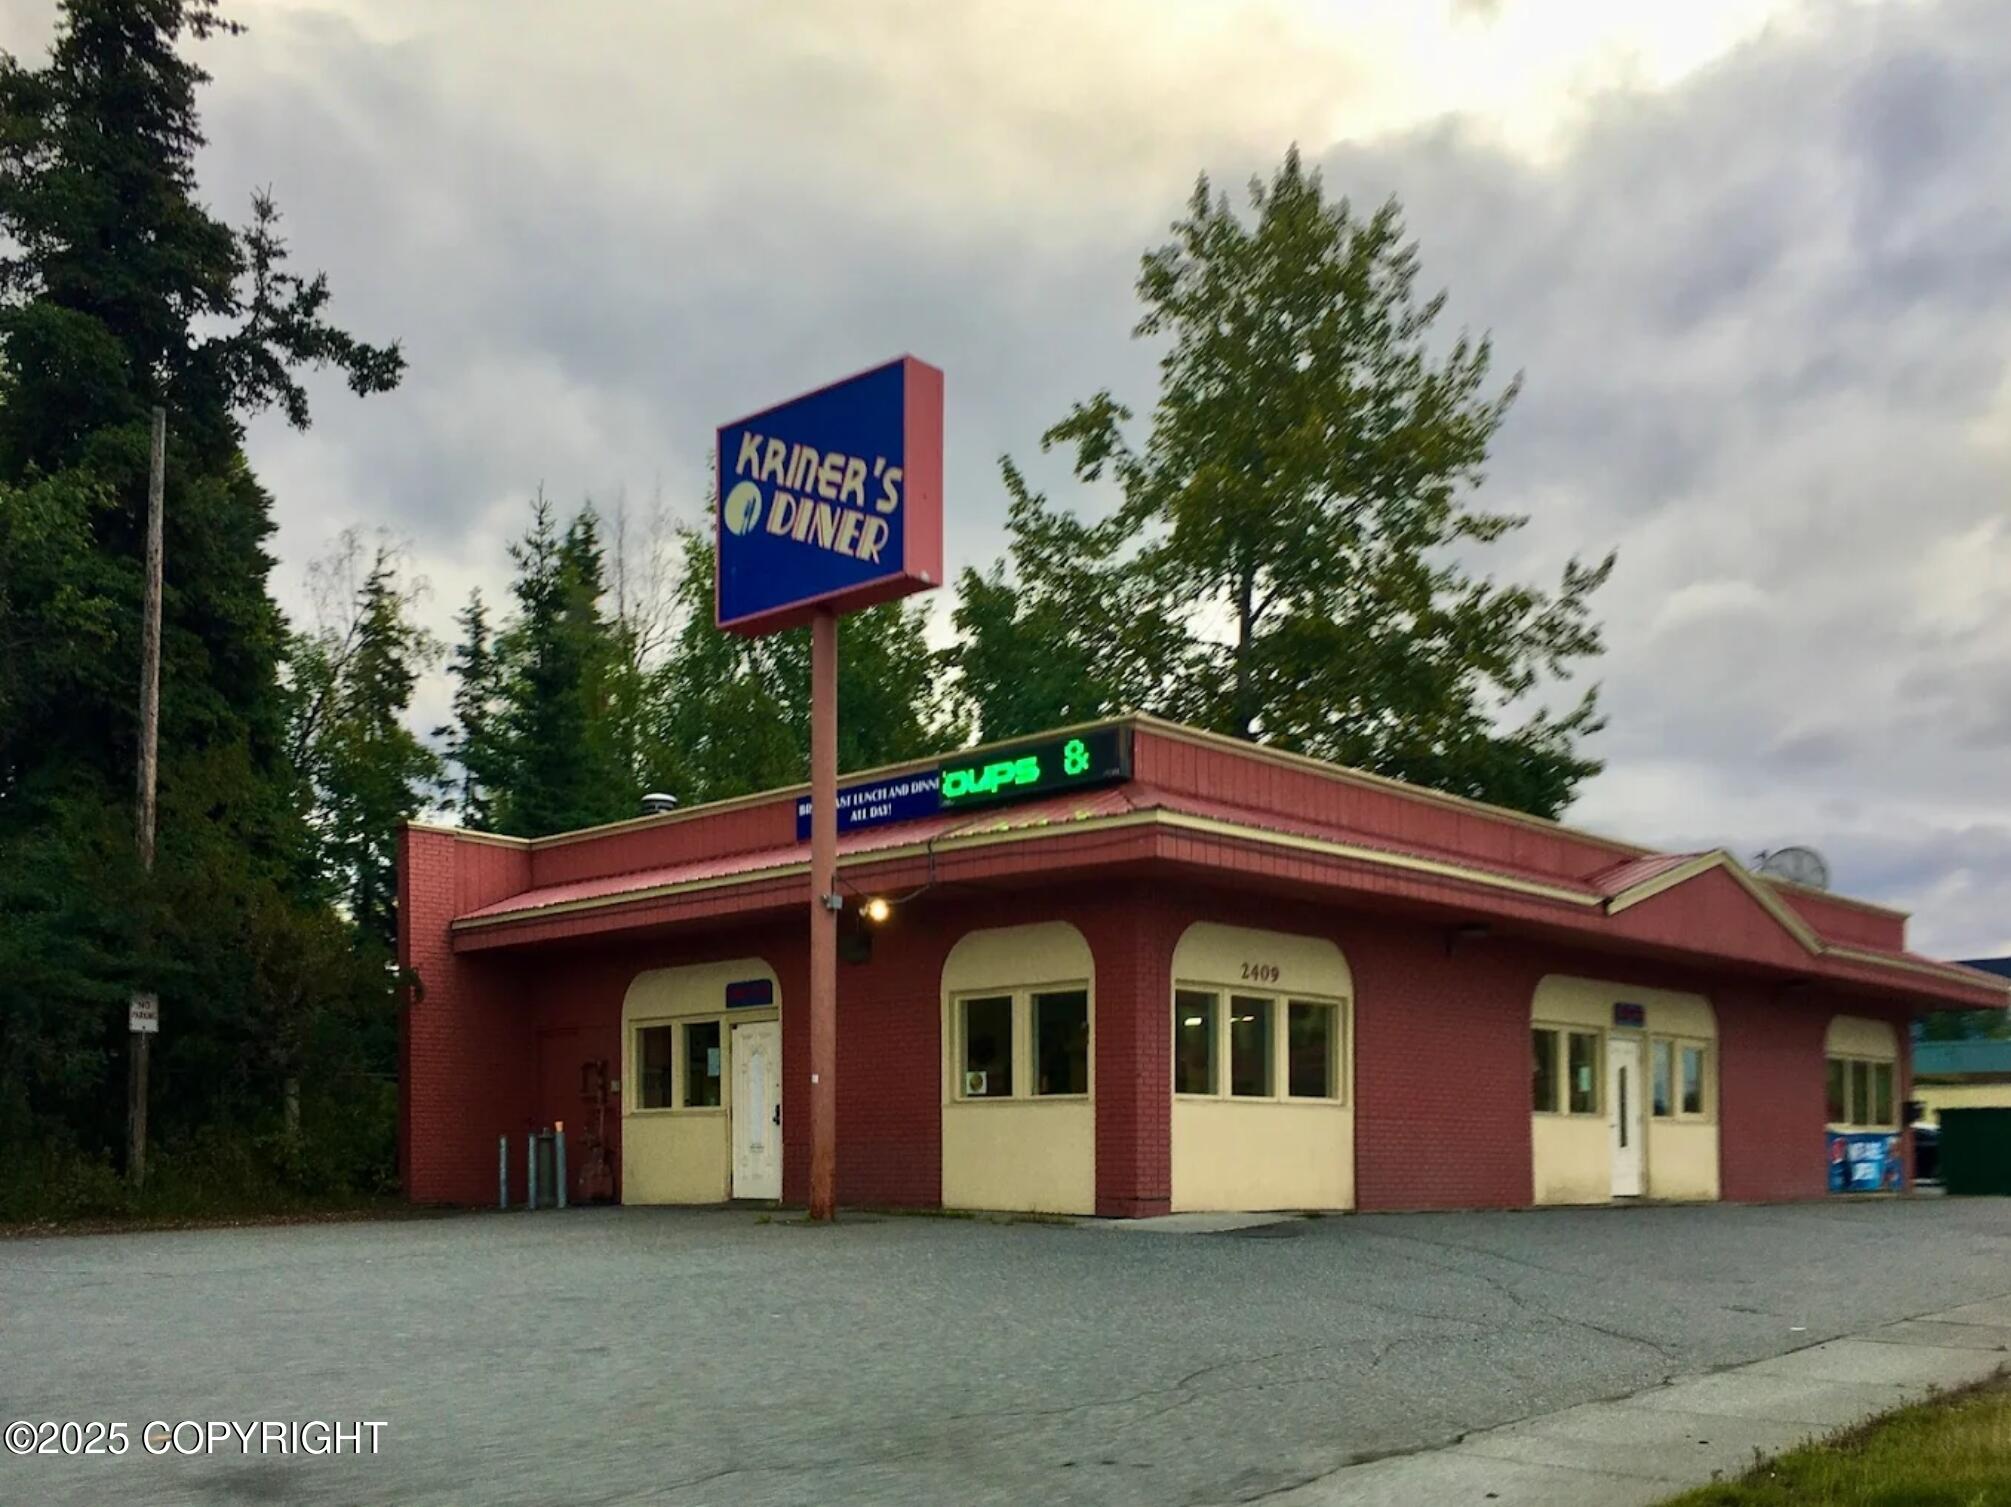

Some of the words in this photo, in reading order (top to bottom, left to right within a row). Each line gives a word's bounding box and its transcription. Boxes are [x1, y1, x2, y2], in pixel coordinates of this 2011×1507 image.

[735, 430, 902, 514] KRINER'S
[766, 489, 889, 565] DINER
[942, 756, 1040, 798] OUPS
[1064, 739, 1090, 775] &
[850, 806, 867, 822] ALL
[870, 803, 892, 818] DAY!
[853, 790, 887, 805] LUNCH
[888, 785, 909, 799] AND
[1240, 962, 1280, 982] 2409
